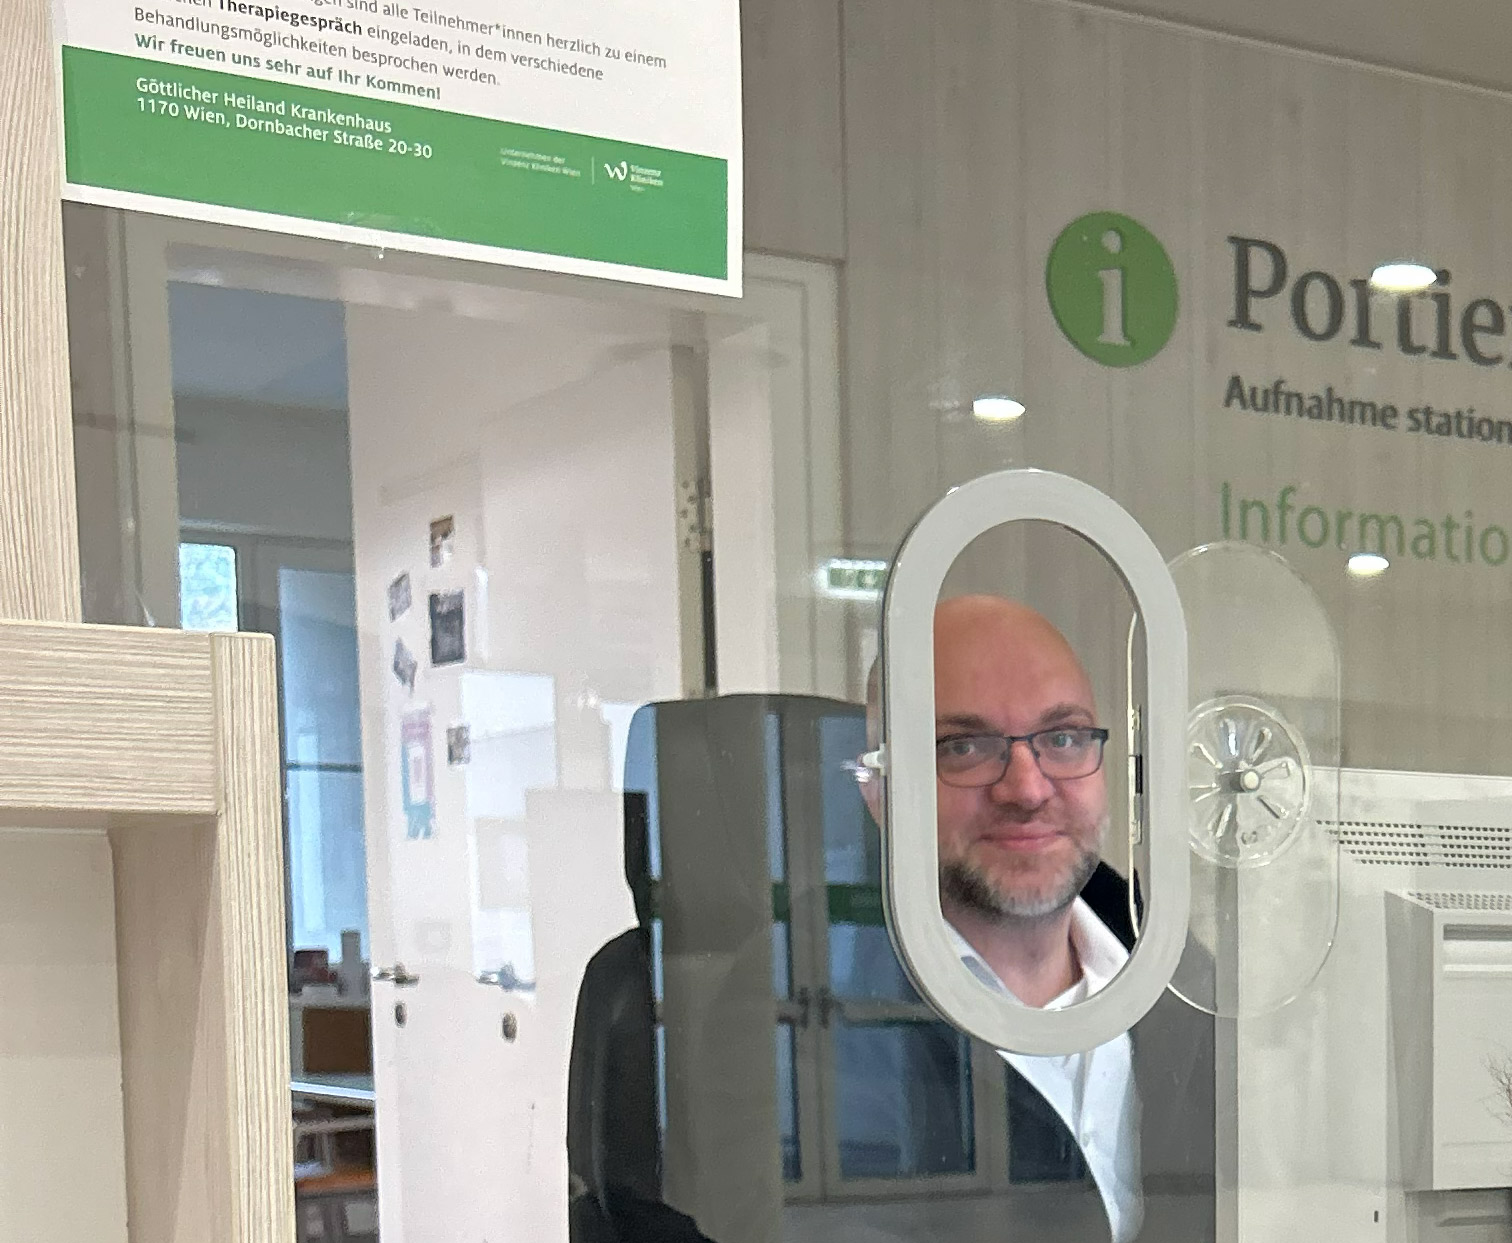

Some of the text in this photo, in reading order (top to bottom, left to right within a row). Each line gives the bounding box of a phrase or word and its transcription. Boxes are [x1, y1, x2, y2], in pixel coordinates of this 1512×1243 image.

[134, 7, 500, 86] Behandlungsmöglichkeiten besprochen werden.
[134, 33, 441, 100] Wir freuen uns sehr auf Ihr Kommen!
[219, 0, 603, 81] Therapiegespräch eingeladen, in dem verschiedene
[383, 3, 409, 19] alle
[546, 33, 601, 56] herzlich
[605, 47, 620, 59] zu
[625, 51, 667, 69] einem
[136, 76, 392, 134] Göttlicher Heiland Krankenhaus
[136, 97, 433, 159] 1170 Wien, Dornbacher Straße 20-30
[1224, 374, 1398, 430] Aufnahme
